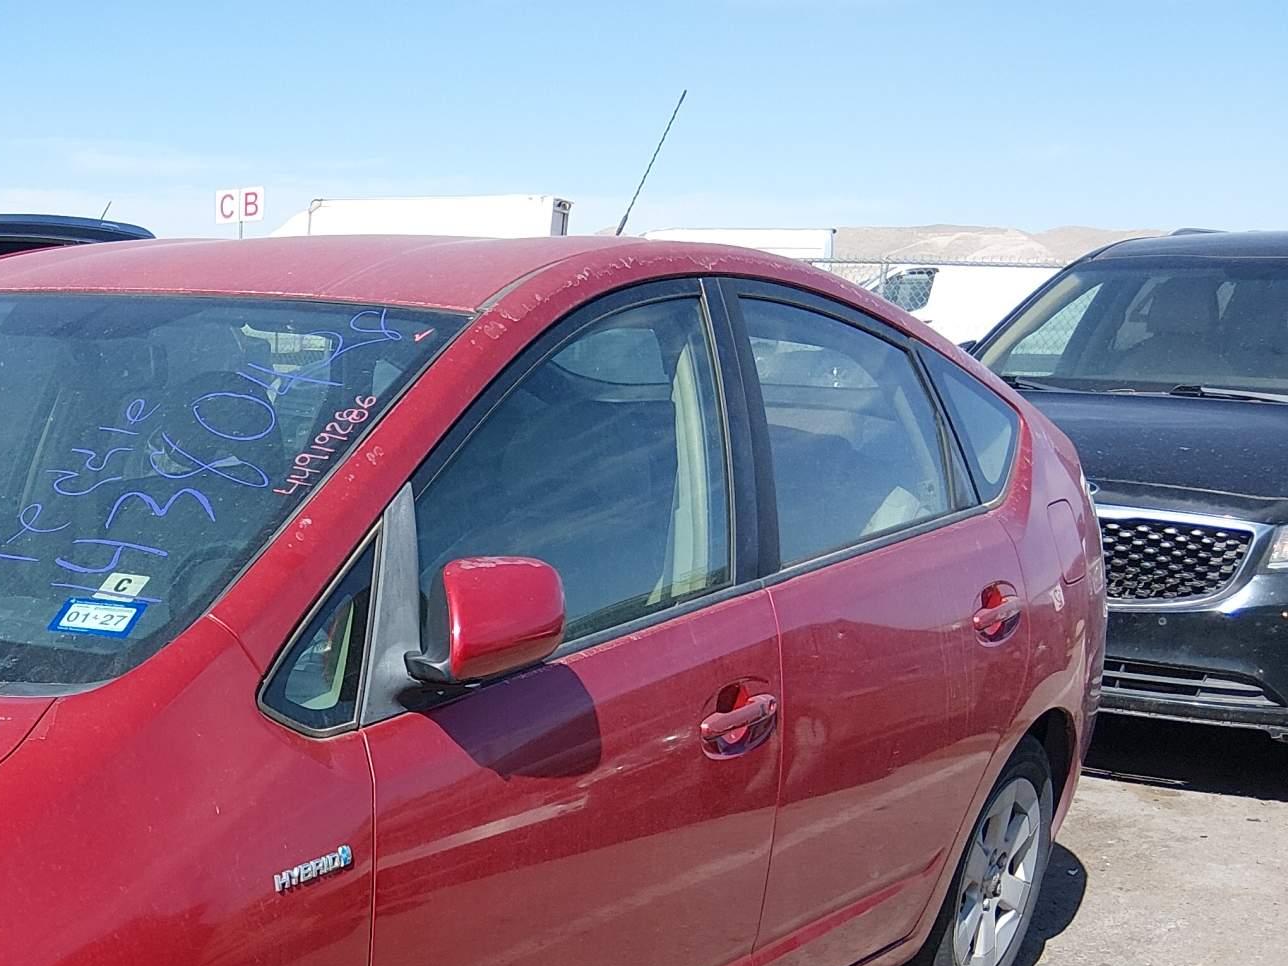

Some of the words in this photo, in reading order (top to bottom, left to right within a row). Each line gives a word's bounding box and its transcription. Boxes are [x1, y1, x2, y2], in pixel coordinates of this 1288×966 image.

[220, 193, 235, 219] C
[244, 191, 258, 217] B
[272, 394, 377, 495] 44919286
[113, 577, 133, 593] C
[273, 851, 342, 893] HYBRID
